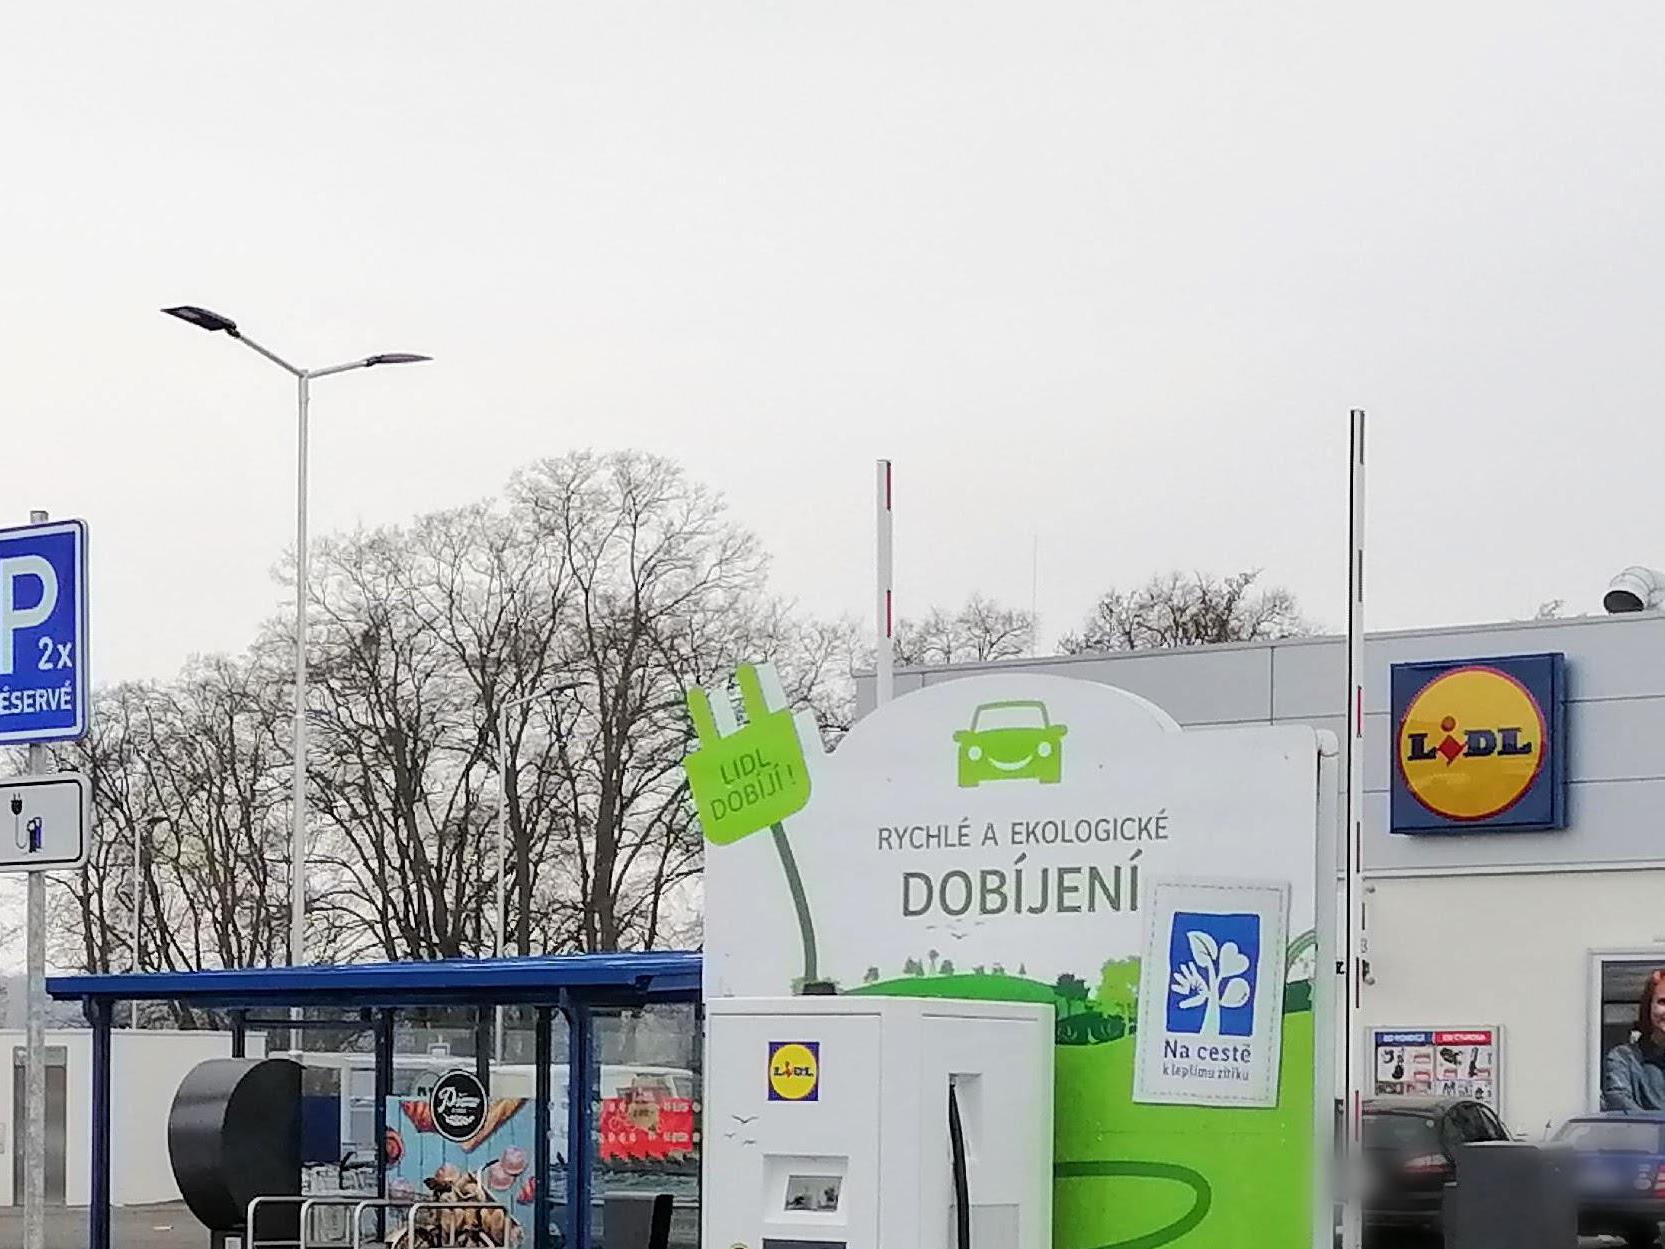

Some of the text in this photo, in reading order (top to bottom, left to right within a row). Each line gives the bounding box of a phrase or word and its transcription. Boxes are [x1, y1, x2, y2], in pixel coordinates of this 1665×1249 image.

[37, 636, 73, 671] 2x
[720, 747, 771, 785] LIDL
[877, 807, 1170, 850] RYCHLÉ A EKOLOGICKÉ
[901, 847, 1143, 916] DOBÍJENÍ
[1163, 1039, 1252, 1063] Na cestě
